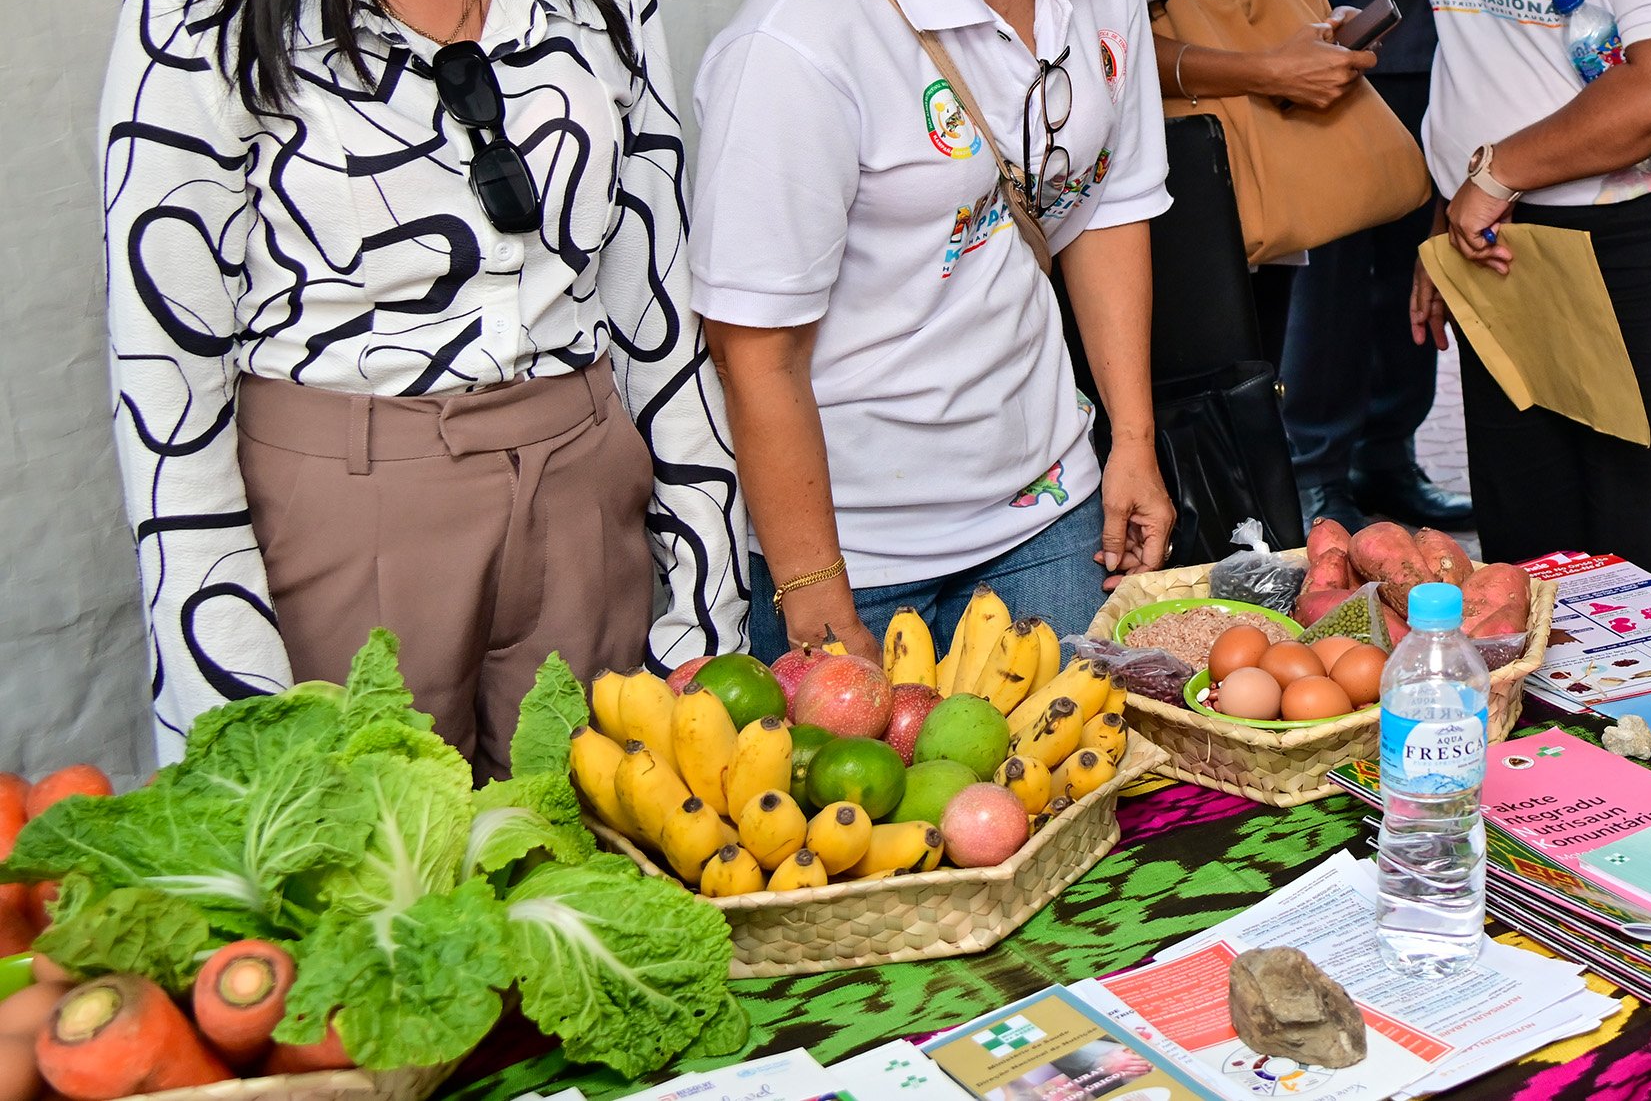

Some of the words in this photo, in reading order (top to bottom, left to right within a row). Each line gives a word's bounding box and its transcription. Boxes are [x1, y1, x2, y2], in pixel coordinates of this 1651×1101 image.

[1405, 738, 1484, 761] FRESCA
[1437, 736, 1463, 745] AQUA
[1493, 796, 1607, 826] Integradu
[1512, 805, 1627, 838] Nutrisaun
